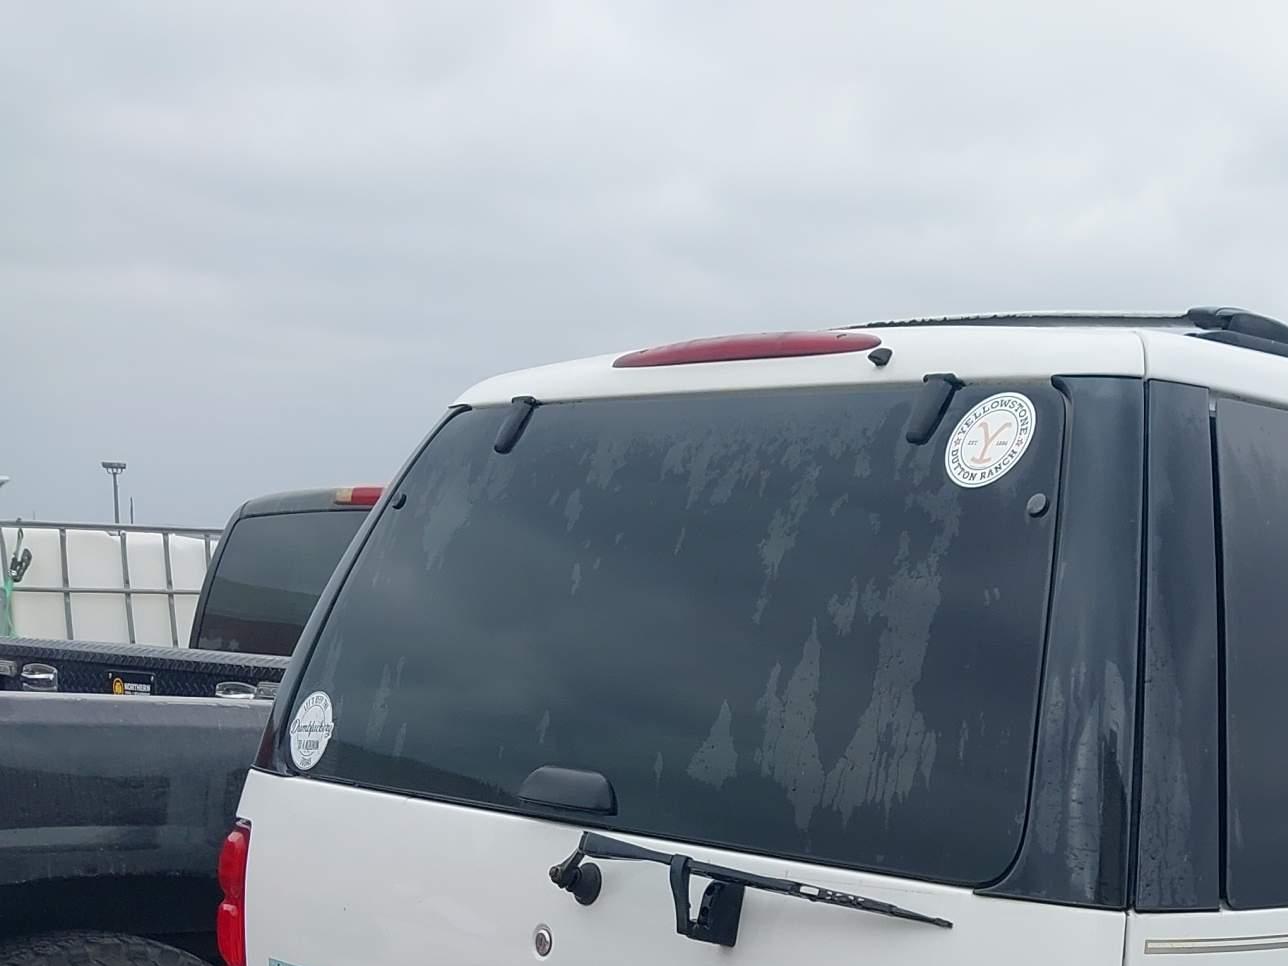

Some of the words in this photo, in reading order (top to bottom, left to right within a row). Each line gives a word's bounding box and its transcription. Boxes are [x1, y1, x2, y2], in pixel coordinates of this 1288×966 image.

[958, 399, 1030, 436] YELLOWSTONE
[951, 448, 977, 481] DUTTON
[979, 449, 1017, 481] RANCH
